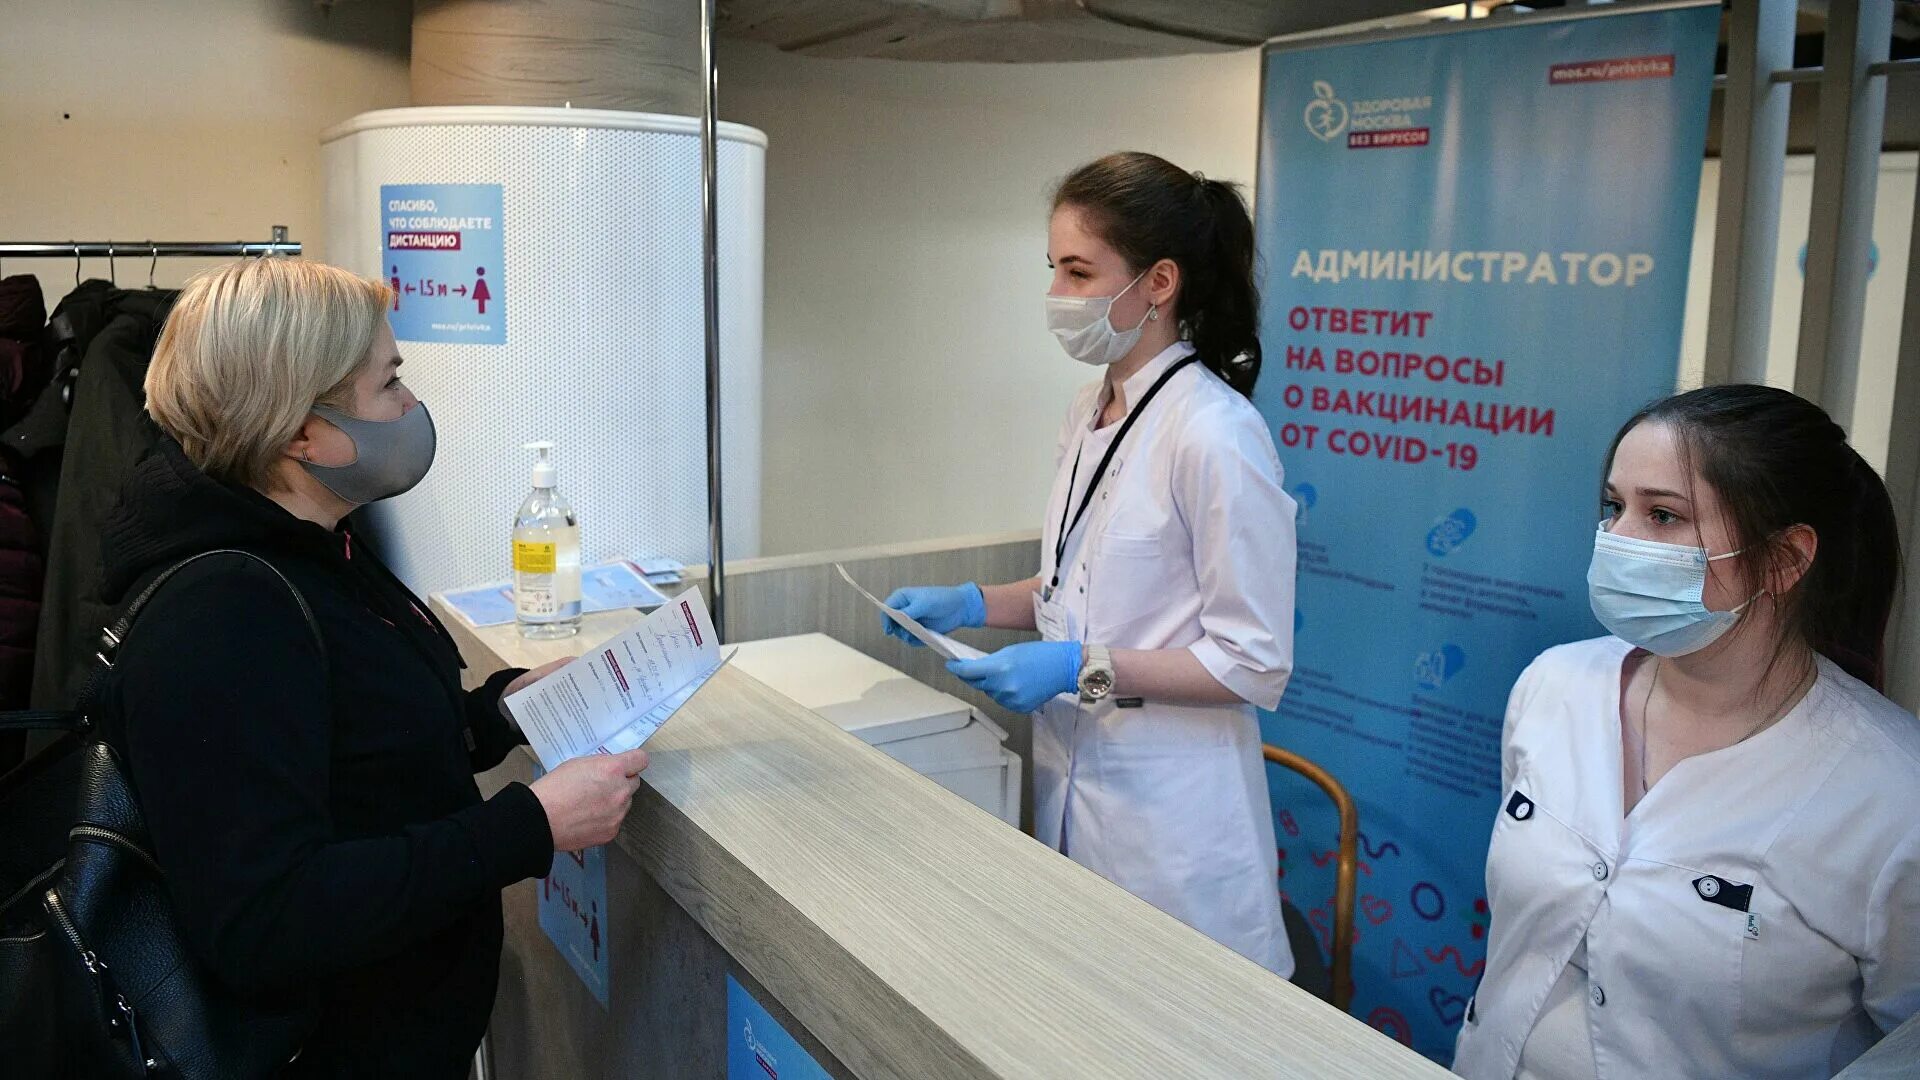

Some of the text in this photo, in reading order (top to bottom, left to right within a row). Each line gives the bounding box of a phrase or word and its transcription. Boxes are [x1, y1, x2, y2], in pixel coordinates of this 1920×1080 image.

[389, 200, 438, 213] СПАСИБО,
[389, 217, 492, 231] ЧТО СОБЛЮДАЕТЕ
[389, 234, 457, 249] ДИСТАНЦИЮ
[1292, 248, 1655, 288] АДМИНИСТРАТОР
[1289, 305, 1433, 338] ОТВЕТИТ
[1286, 345, 1504, 387] НА ВОПРОСЫ
[1283, 384, 1555, 437] О ВАКЦИНАЦИИ
[1280, 423, 1478, 472] ОТ COVID-19
